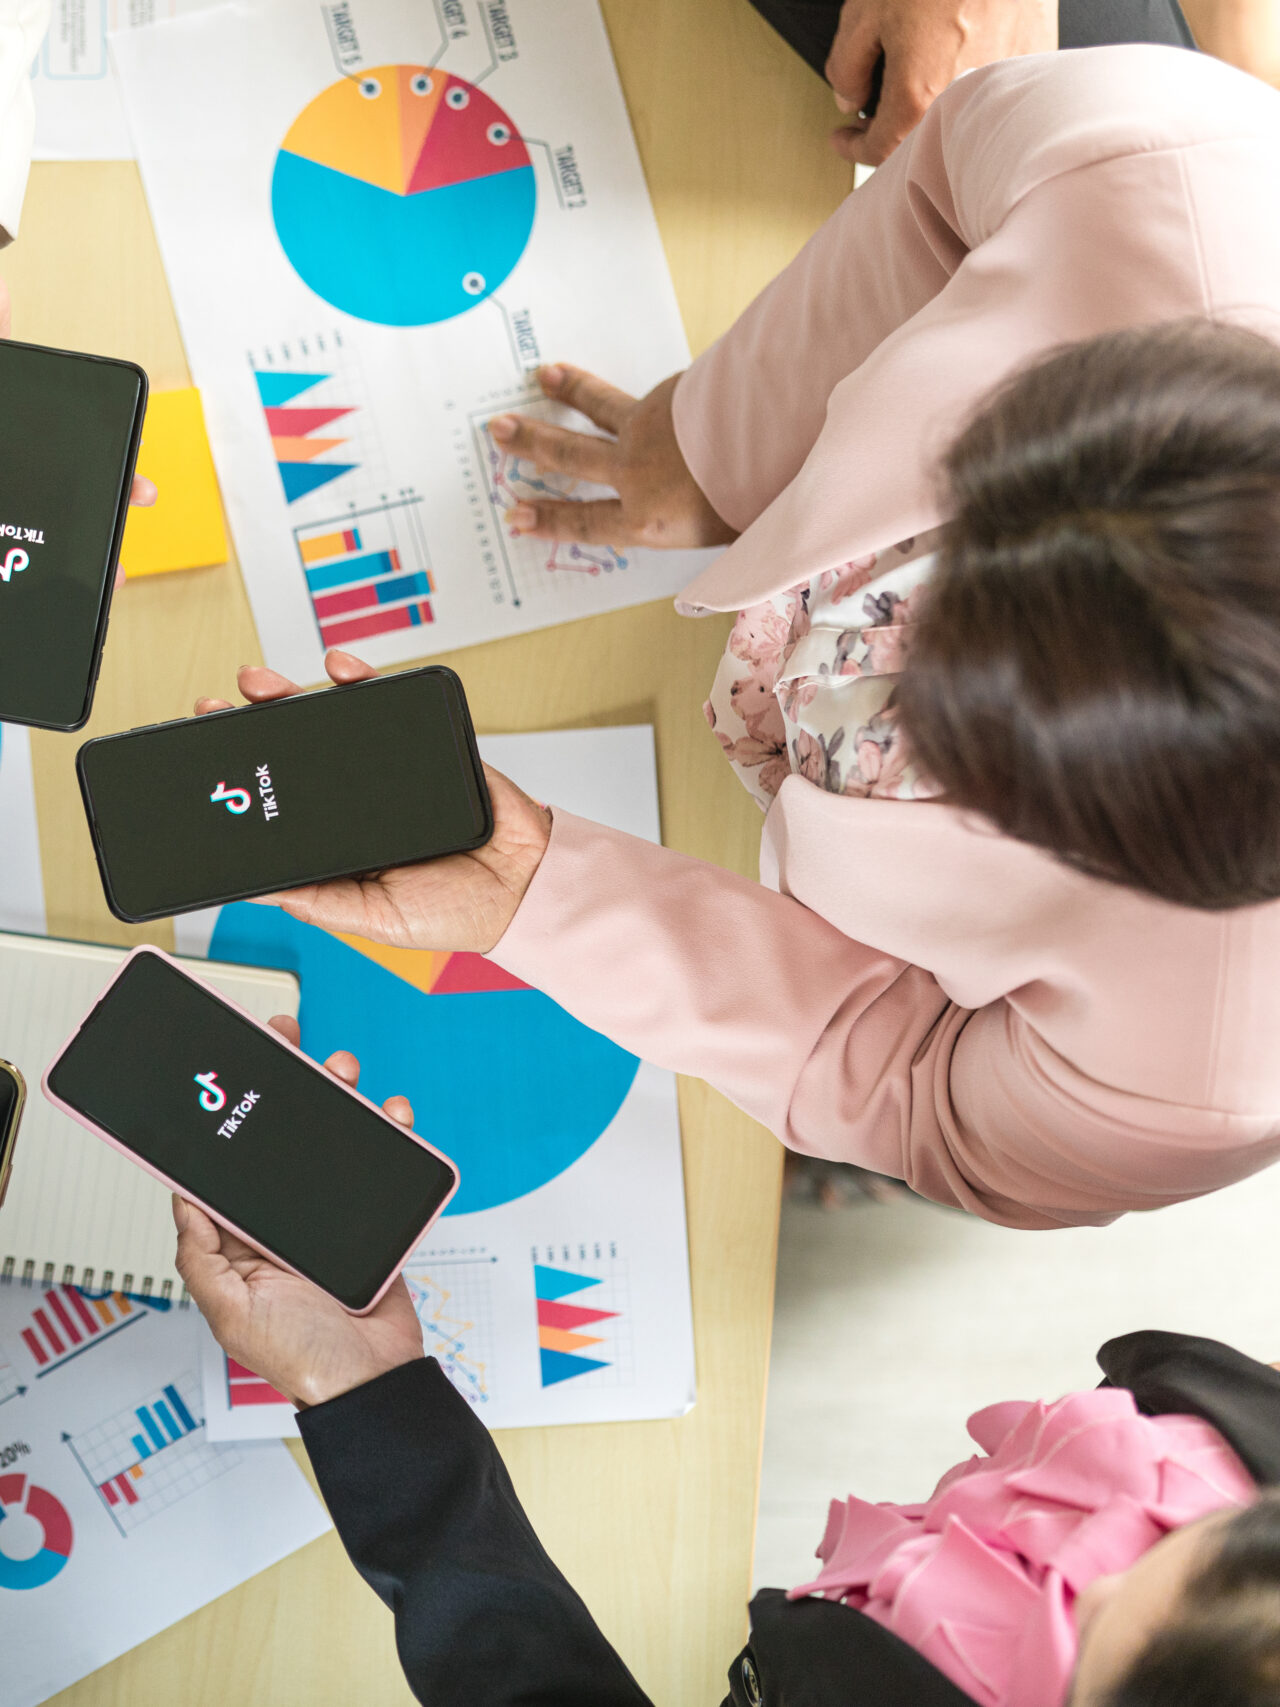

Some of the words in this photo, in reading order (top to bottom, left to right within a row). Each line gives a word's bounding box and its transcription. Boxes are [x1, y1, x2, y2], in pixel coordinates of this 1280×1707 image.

[331, 1, 360, 52] TARGET
[554, 144, 585, 197] TARGET
[567, 198, 588, 210] 2
[511, 308, 541, 360] TARGET
[254, 763, 280, 822] TikTok
[216, 1089, 261, 1140] TikTok
